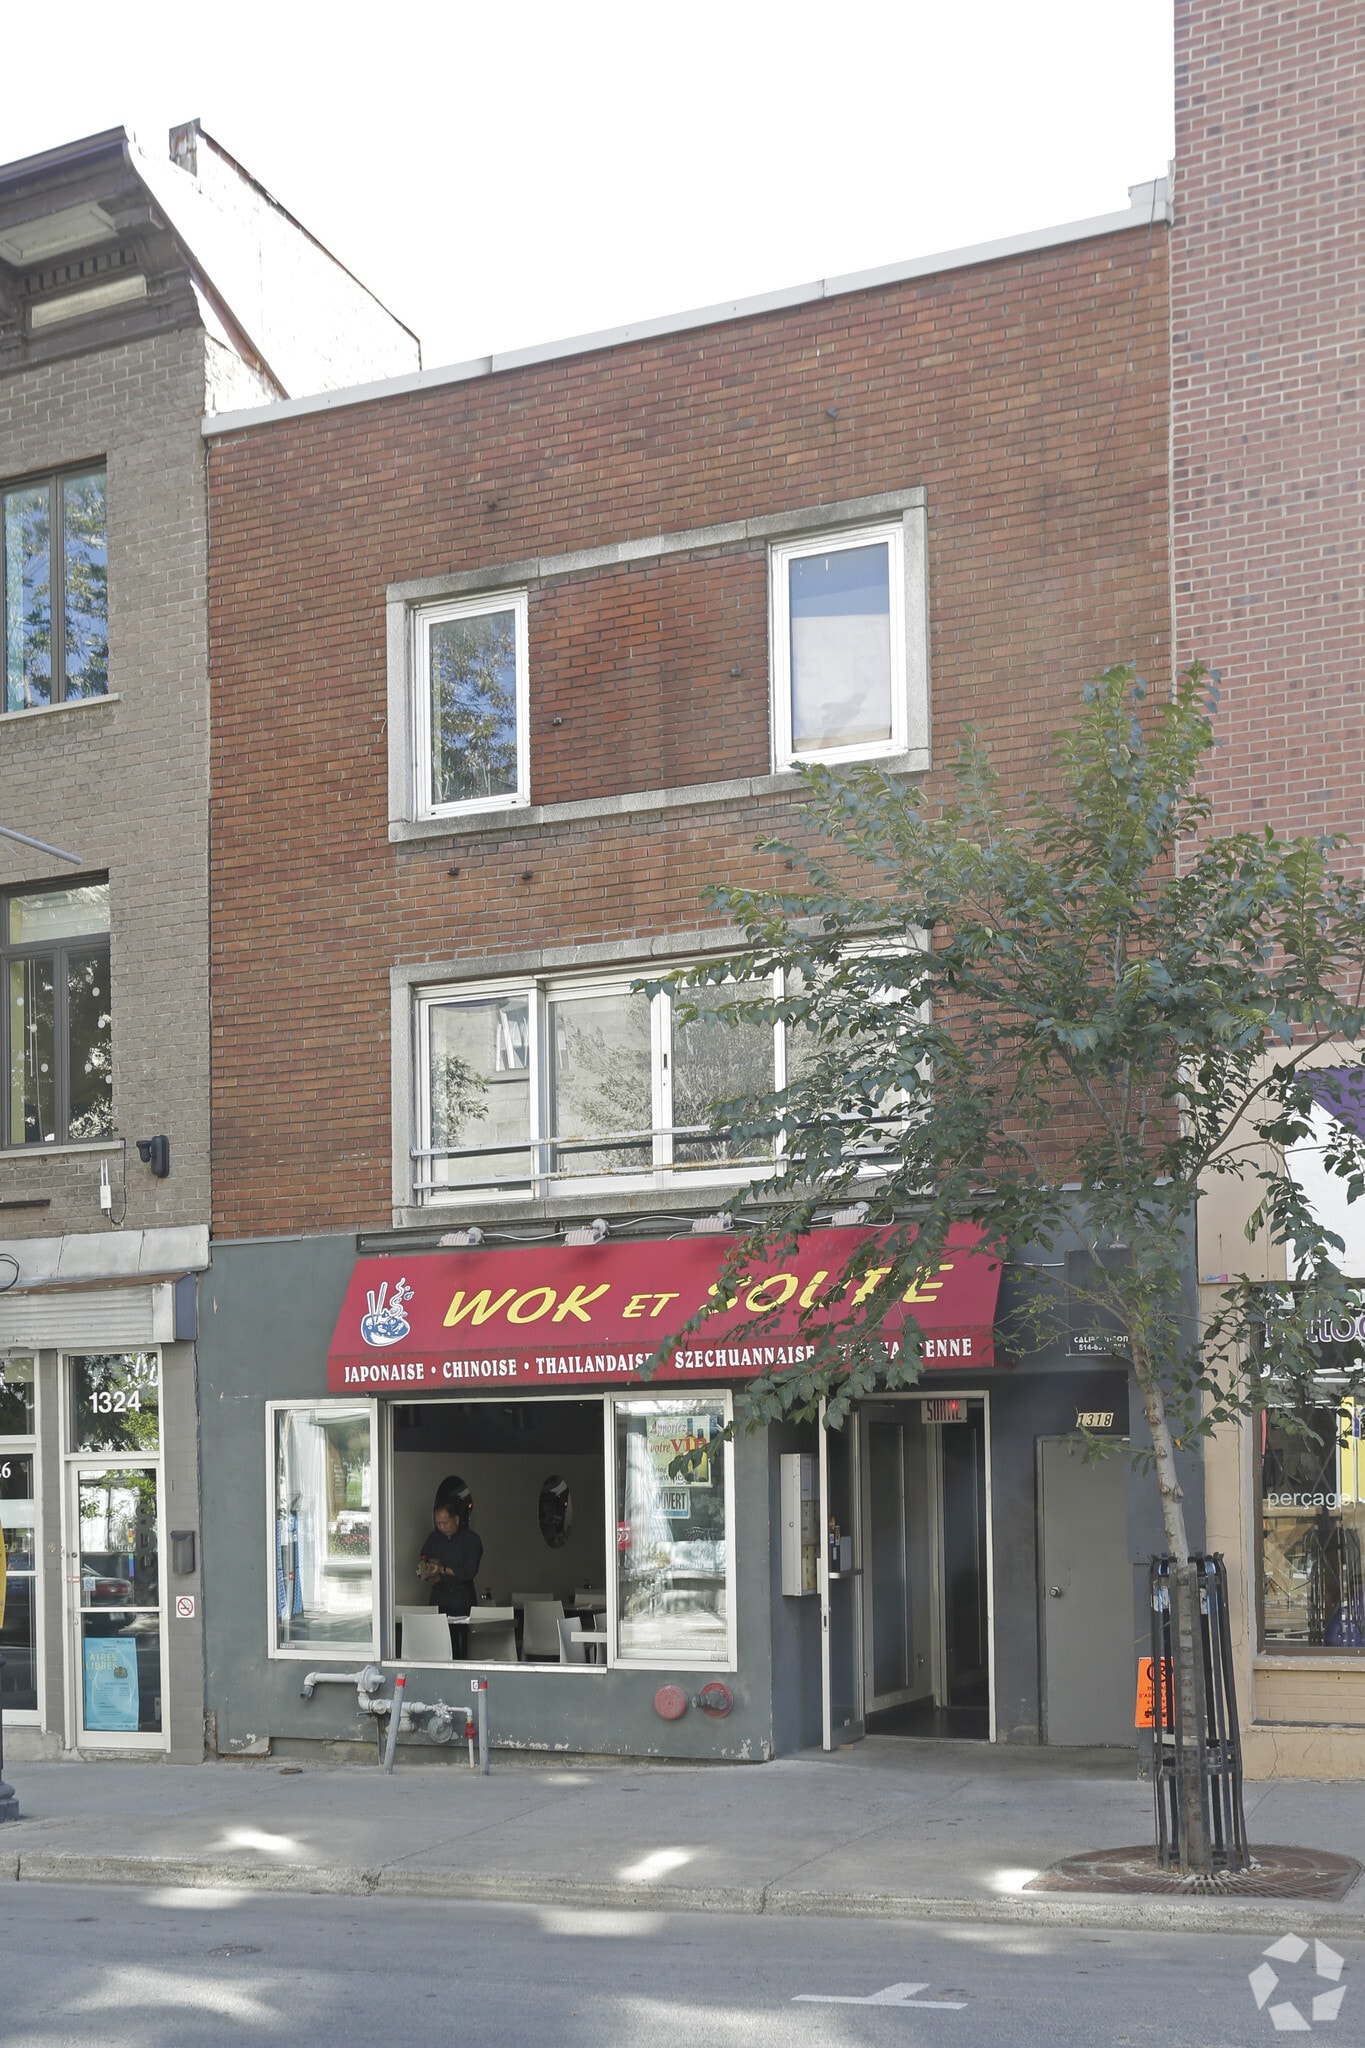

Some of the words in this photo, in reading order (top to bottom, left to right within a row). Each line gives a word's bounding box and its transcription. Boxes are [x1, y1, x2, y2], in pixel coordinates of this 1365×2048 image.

[443, 1283, 611, 1327] WOK
[622, 1292, 680, 1318] ET
[344, 1363, 425, 1384] JAPONAISE
[442, 1358, 517, 1379] CHINOISE
[89, 1391, 142, 1414] 1324
[1079, 1413, 1112, 1426] 1318
[0, 1461, 12, 1479] 6
[655, 1492, 686, 1510] OUVERT
[1267, 1492, 1351, 1510] perçage
